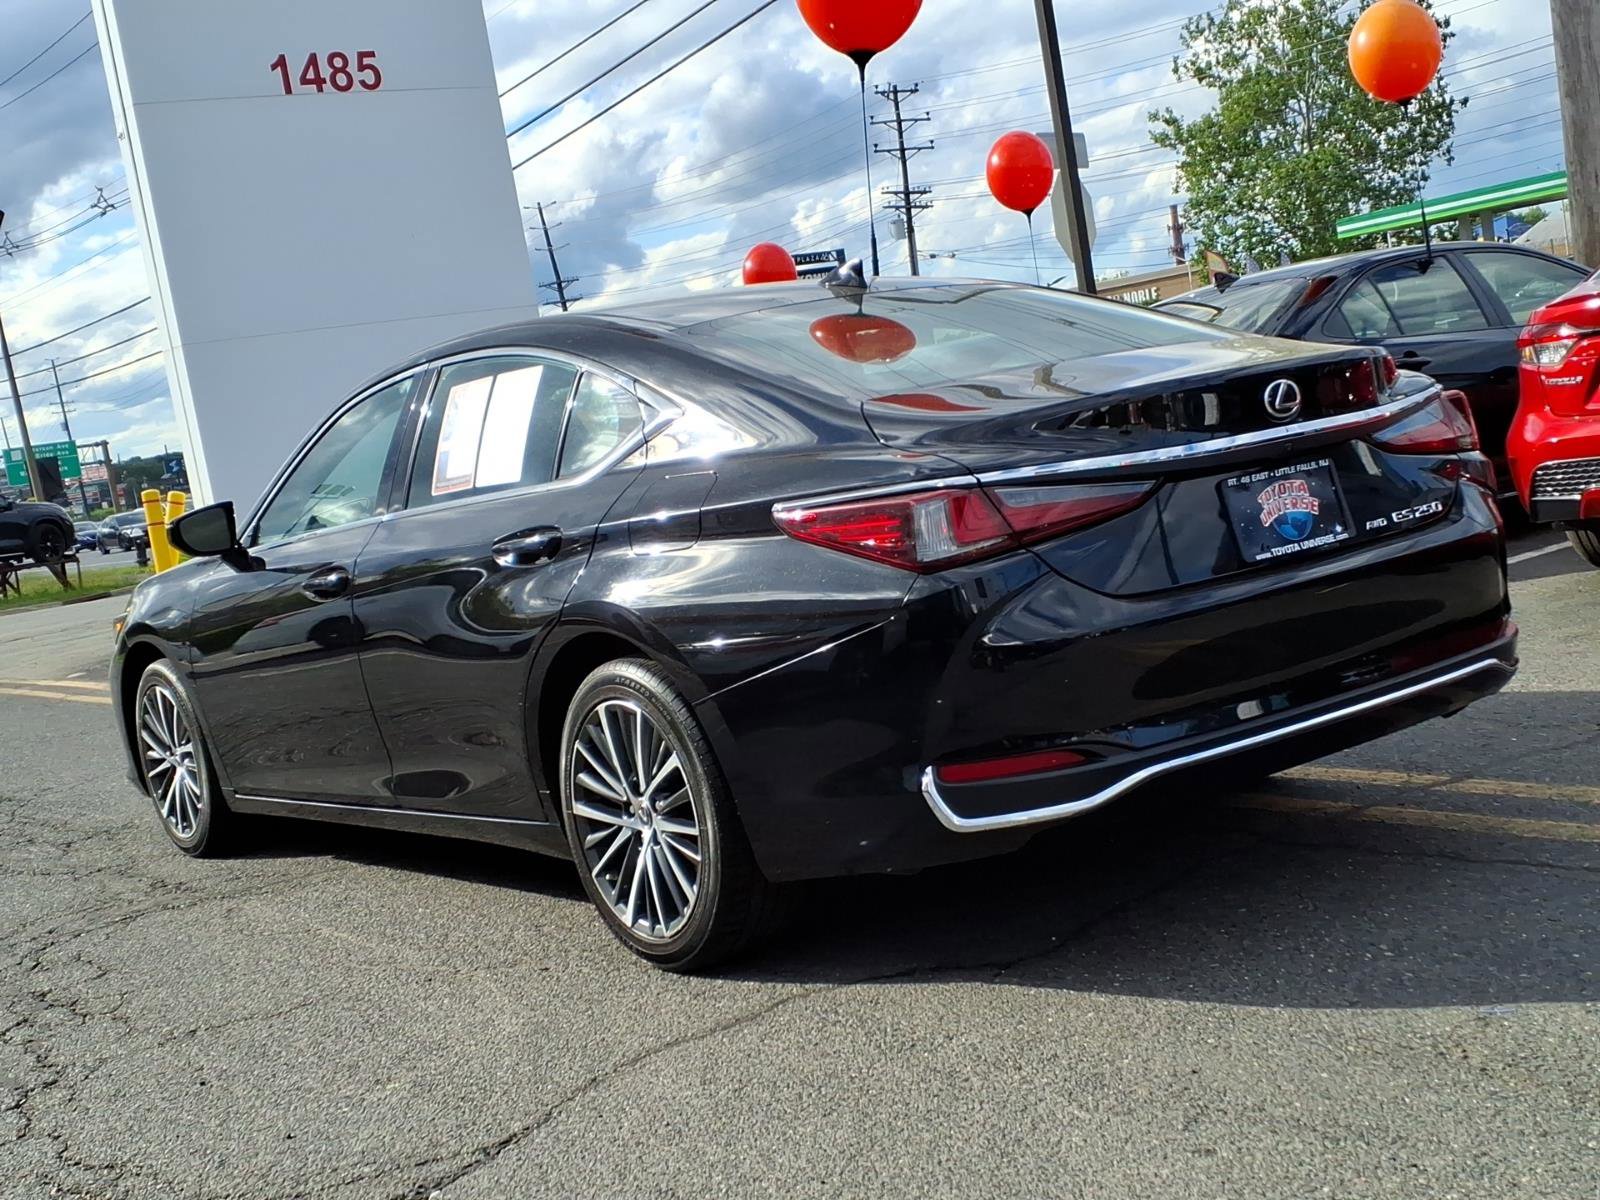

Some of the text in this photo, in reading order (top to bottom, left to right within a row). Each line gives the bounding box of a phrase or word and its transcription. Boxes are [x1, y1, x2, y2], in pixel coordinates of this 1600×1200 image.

[270, 51, 382, 95] 1485
[1251, 471, 1269, 482] EAST
[1274, 466, 1297, 477] LITTLE
[1318, 458, 1329, 467] NJ
[1257, 480, 1309, 506] TOYOTA
[1260, 496, 1319, 527] UNIVERSE
[1365, 501, 1444, 531] AWD ES 250
